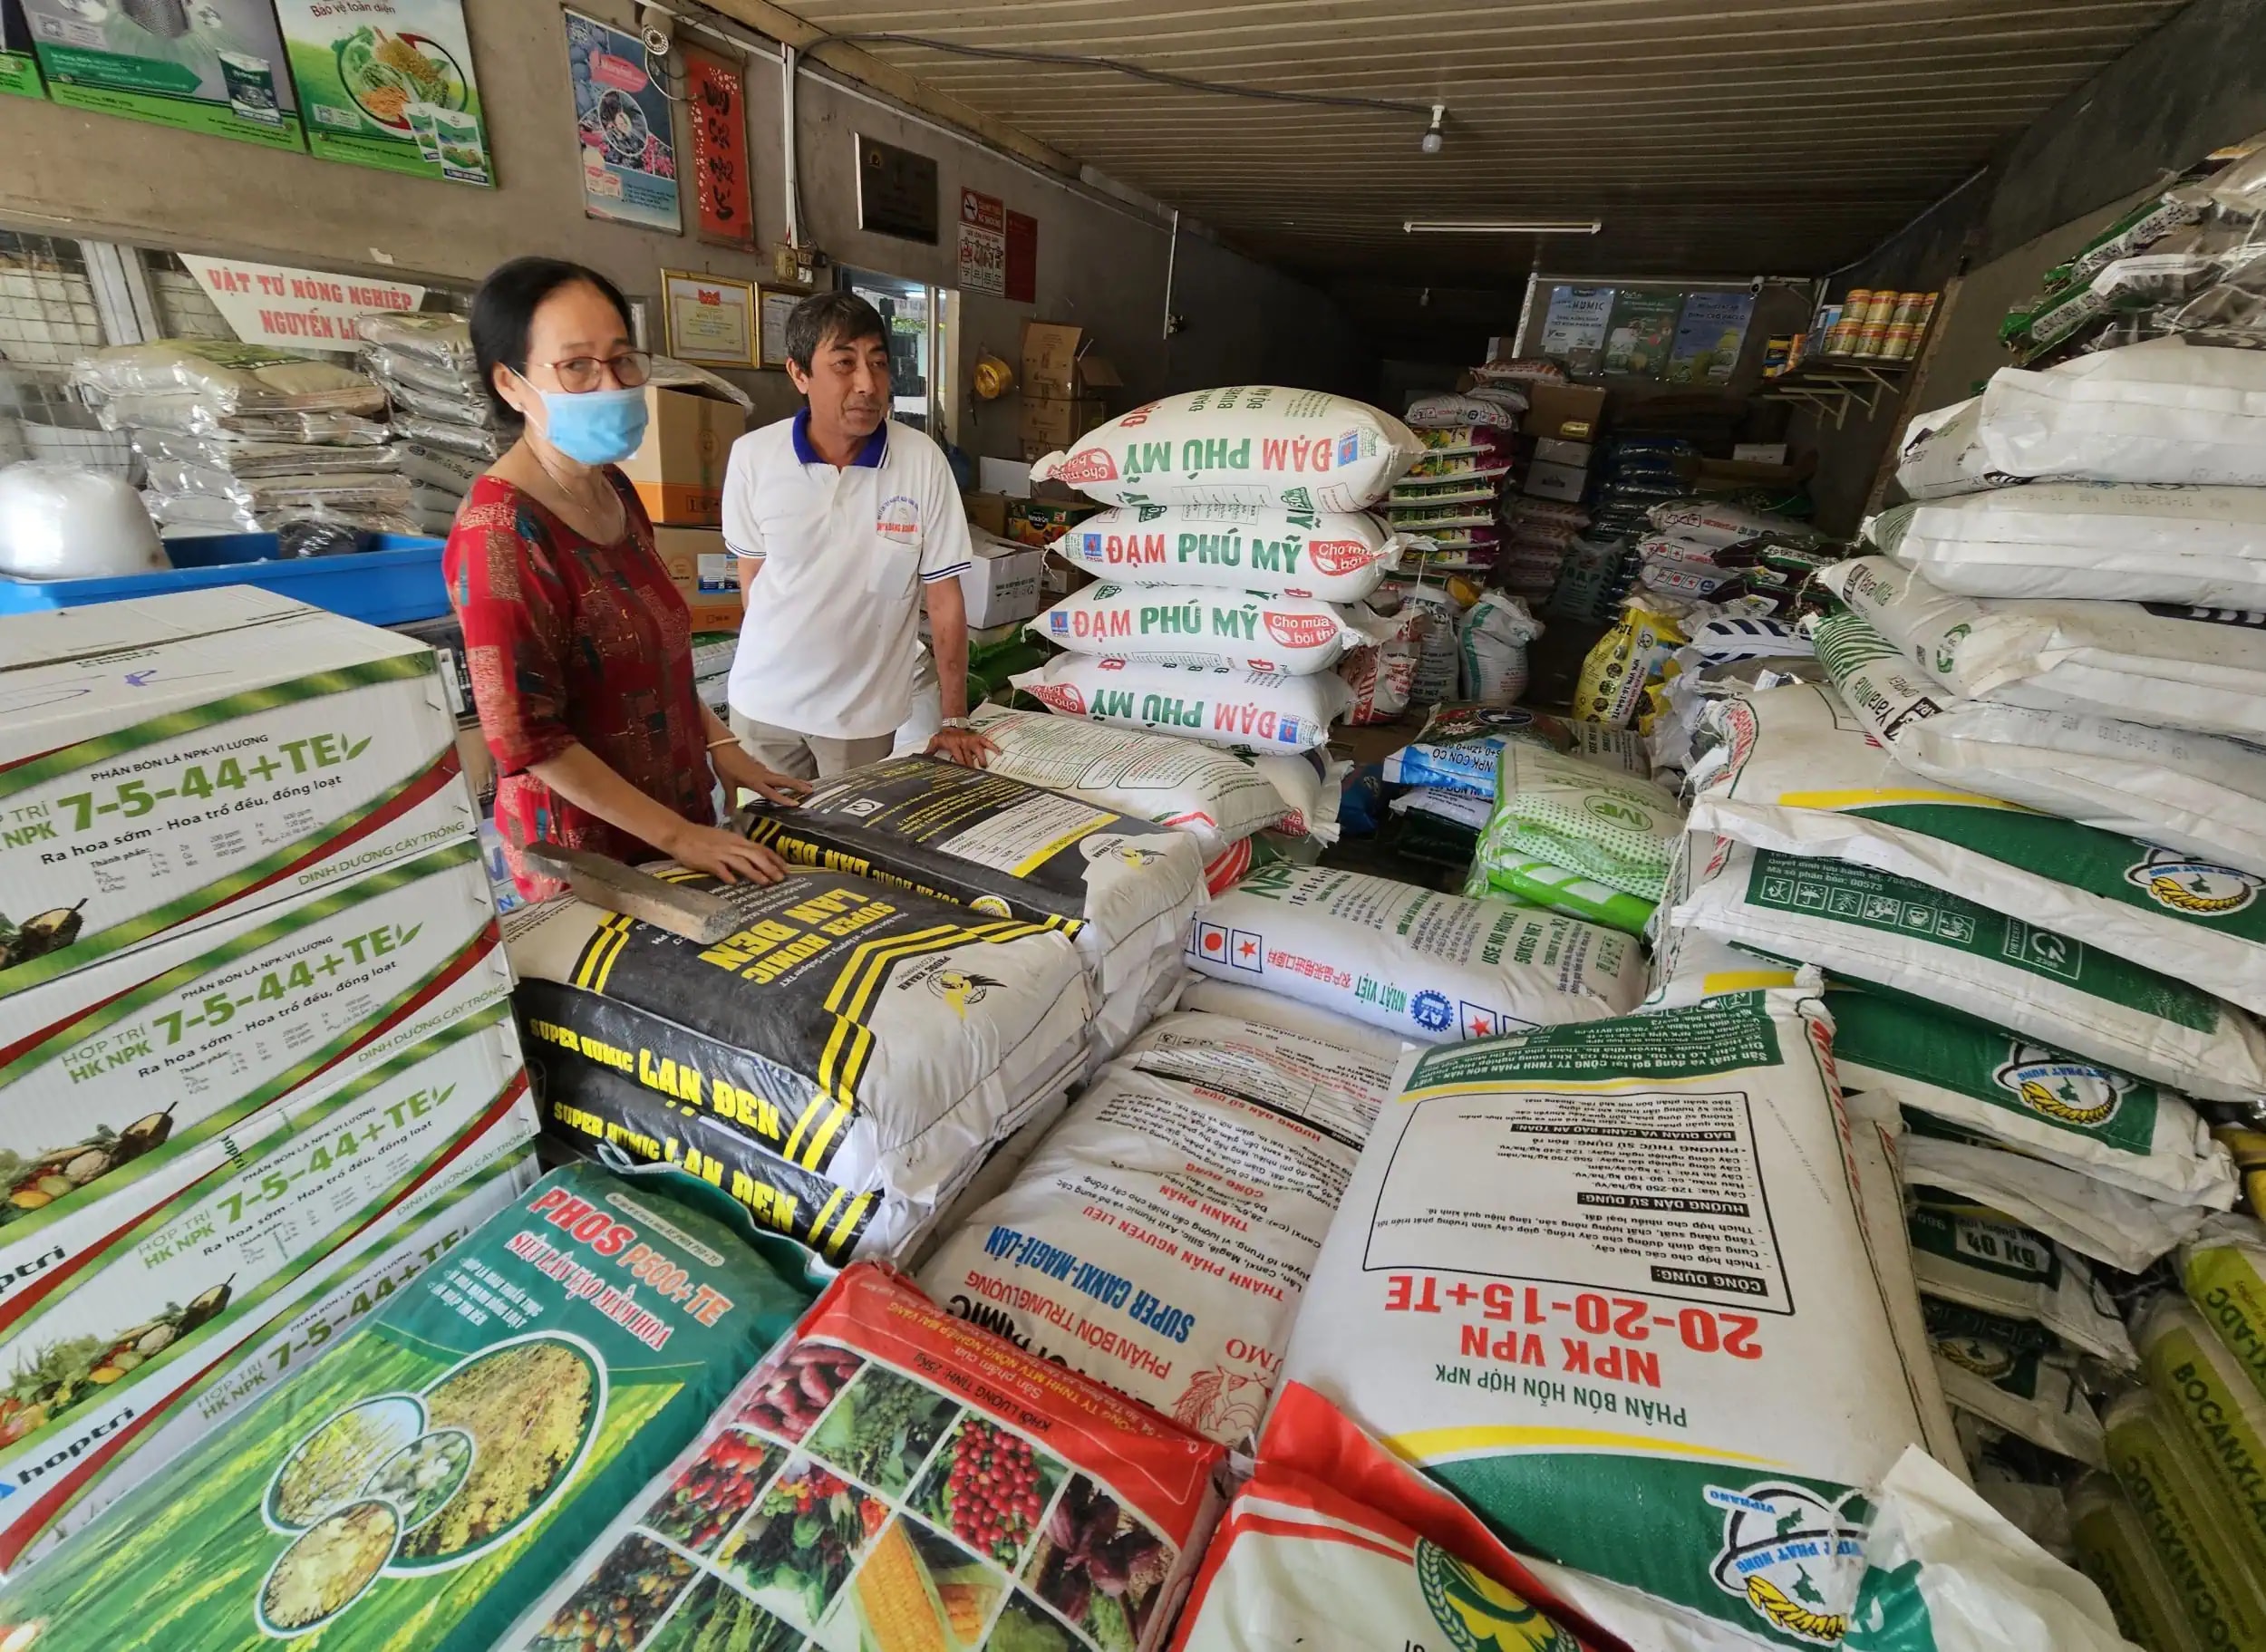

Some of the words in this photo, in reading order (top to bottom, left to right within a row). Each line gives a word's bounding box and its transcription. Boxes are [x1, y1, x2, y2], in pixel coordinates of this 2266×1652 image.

[207, 266, 250, 296] VẬT
[291, 276, 343, 304] NÔNG
[1123, 441, 1171, 484] MỸ
[1182, 438, 1250, 479] PHÚ
[1264, 435, 1332, 473] ĐẠM
[1082, 467, 1107, 478] Cho
[1106, 534, 1167, 568] ĐẠM
[1178, 527, 1241, 566] PHÚ
[1252, 535, 1302, 574] MỸ
[1319, 544, 1346, 555] Cho
[1073, 609, 1131, 642] ĐẠM
[1140, 598, 1201, 634] PHÚ
[1213, 604, 1260, 641] MỸ
[1273, 615, 1298, 628] Cho
[1301, 613, 1330, 628] mùa
[1054, 700, 1078, 712] Cho
[1089, 690, 1135, 721] MỸ
[1142, 694, 1204, 728] PHÚ
[1853, 676, 1894, 727] YaraMila
[1215, 702, 1277, 739] ĐẠM
[91, 767, 131, 781] PHÂN
[134, 758, 163, 772] BÓN
[183, 746, 225, 761] NPK-VI
[1449, 752, 1470, 766] CON
[1471, 757, 1494, 772] NPK
[56, 733, 342, 833] 7-5-44+TE
[40, 851, 66, 865] Ra
[72, 838, 109, 855] hoa
[113, 826, 151, 845] sớm
[167, 814, 202, 830] Hoa
[205, 802, 230, 818] trổ
[234, 797, 269, 812] đều,
[271, 784, 311, 802] đồng
[314, 774, 342, 792] loạt
[3, 819, 60, 849] NPK
[298, 865, 337, 885] DINH
[339, 845, 393, 872] DƯỠNG
[394, 838, 418, 852] CÂY
[420, 821, 466, 843] TRỒNG
[1850, 879, 1883, 891] 00573
[819, 902, 896, 936] SUPER
[1494, 912, 1518, 934] HOOKS
[1524, 921, 1545, 937] NET
[1487, 932, 1507, 946] NO
[1514, 935, 1538, 965] 50KGS
[741, 932, 832, 984] HUMIC
[1481, 945, 1503, 965] USE
[152, 926, 397, 1045] 7-5-44+TE
[217, 971, 242, 987] BÓN
[1354, 973, 1378, 1003] VIỆT
[1379, 982, 1408, 1013] NHẬT
[139, 1066, 160, 1077] Ra
[165, 1049, 195, 1067] hoa
[199, 1032, 233, 1052] sớm
[245, 1013, 276, 1030] Hoa
[278, 999, 301, 1017] trổ
[335, 974, 369, 992] đồng
[372, 961, 397, 977] loạt
[529, 1018, 579, 1051] SUPER
[580, 1036, 634, 1073] HUMIC
[69, 1064, 102, 1083] HK
[106, 1040, 153, 1068] NPK
[1489, 1062, 1520, 1075] PHÂN
[1524, 1060, 1553, 1071] TNHH
[1555, 1060, 1571, 1069] TY
[1574, 1059, 1608, 1070] CÔNG
[1656, 1059, 1686, 1069] đóng
[553, 1101, 604, 1138] SUPER
[606, 1122, 661, 1160] HUMIC
[217, 1087, 432, 1224] 7-5-44+TE
[1581, 1193, 1624, 1206] DỤNG:
[1653, 1197, 1684, 1211] DẪN
[1690, 1198, 1744, 1216] HƯỚNG
[1082, 1204, 1117, 1226] LIỆU
[1126, 1205, 1157, 1223] Humic
[1200, 1203, 1248, 1232] THÀNH
[1118, 1220, 1178, 1257] NGUYÊN
[1157, 1220, 1178, 1234] Axit
[1192, 1222, 1219, 1242] lượng
[1719, 1222, 1753, 1234] Thích
[1182, 1232, 1205, 1248] Silic,
[1235, 1241, 1265, 1262] trung,
[1618, 1247, 1641, 1257] loại
[1626, 1234, 1665, 1249] dưỡng
[1668, 1239, 1695, 1250] dinh
[1726, 1244, 1759, 1259] Cung
[527, 1186, 637, 1255] PHOS
[616, 1242, 735, 1328] P500+TE
[1180, 1251, 1225, 1278] PHẦN
[1208, 1243, 1241, 1263] Magiê,
[1691, 1252, 1721, 1264] hợp
[1725, 1258, 1761, 1271] Thích
[983, 1225, 1132, 1309] CANXI-MAGIÊ-LÂN
[1244, 1259, 1277, 1278] Canxi,
[1655, 1269, 1709, 1284] DỤNG:
[1228, 1271, 1284, 1301] THÀNH
[1280, 1274, 1302, 1293] Lân,
[1712, 1274, 1762, 1291] CÔNG
[534, 1251, 580, 1281] LÂN
[563, 1267, 605, 1300] TẠO
[626, 1308, 674, 1352] HOA
[886, 1302, 918, 1323] VÀNG
[918, 1315, 942, 1331] MAI
[1128, 1289, 1196, 1343] SUPER
[1384, 1276, 1763, 1360] 20-20-15+TE
[983, 1345, 1018, 1369] NÔNG
[1460, 1325, 1546, 1368] VPN
[978, 1359, 1016, 1384] phẩm
[1435, 1364, 1471, 1386] NPK
[1559, 1338, 1661, 1389] NPK
[1017, 1378, 1043, 1399] Sản
[1477, 1367, 1517, 1392] HỢP
[1522, 1377, 1566, 1406] HỖN
[1574, 1386, 1617, 1408] BÓN
[1624, 1396, 1688, 1428] PHÂN
[18, 1406, 134, 1485] hoptri
[1709, 1490, 1776, 1514] VIPHANO
